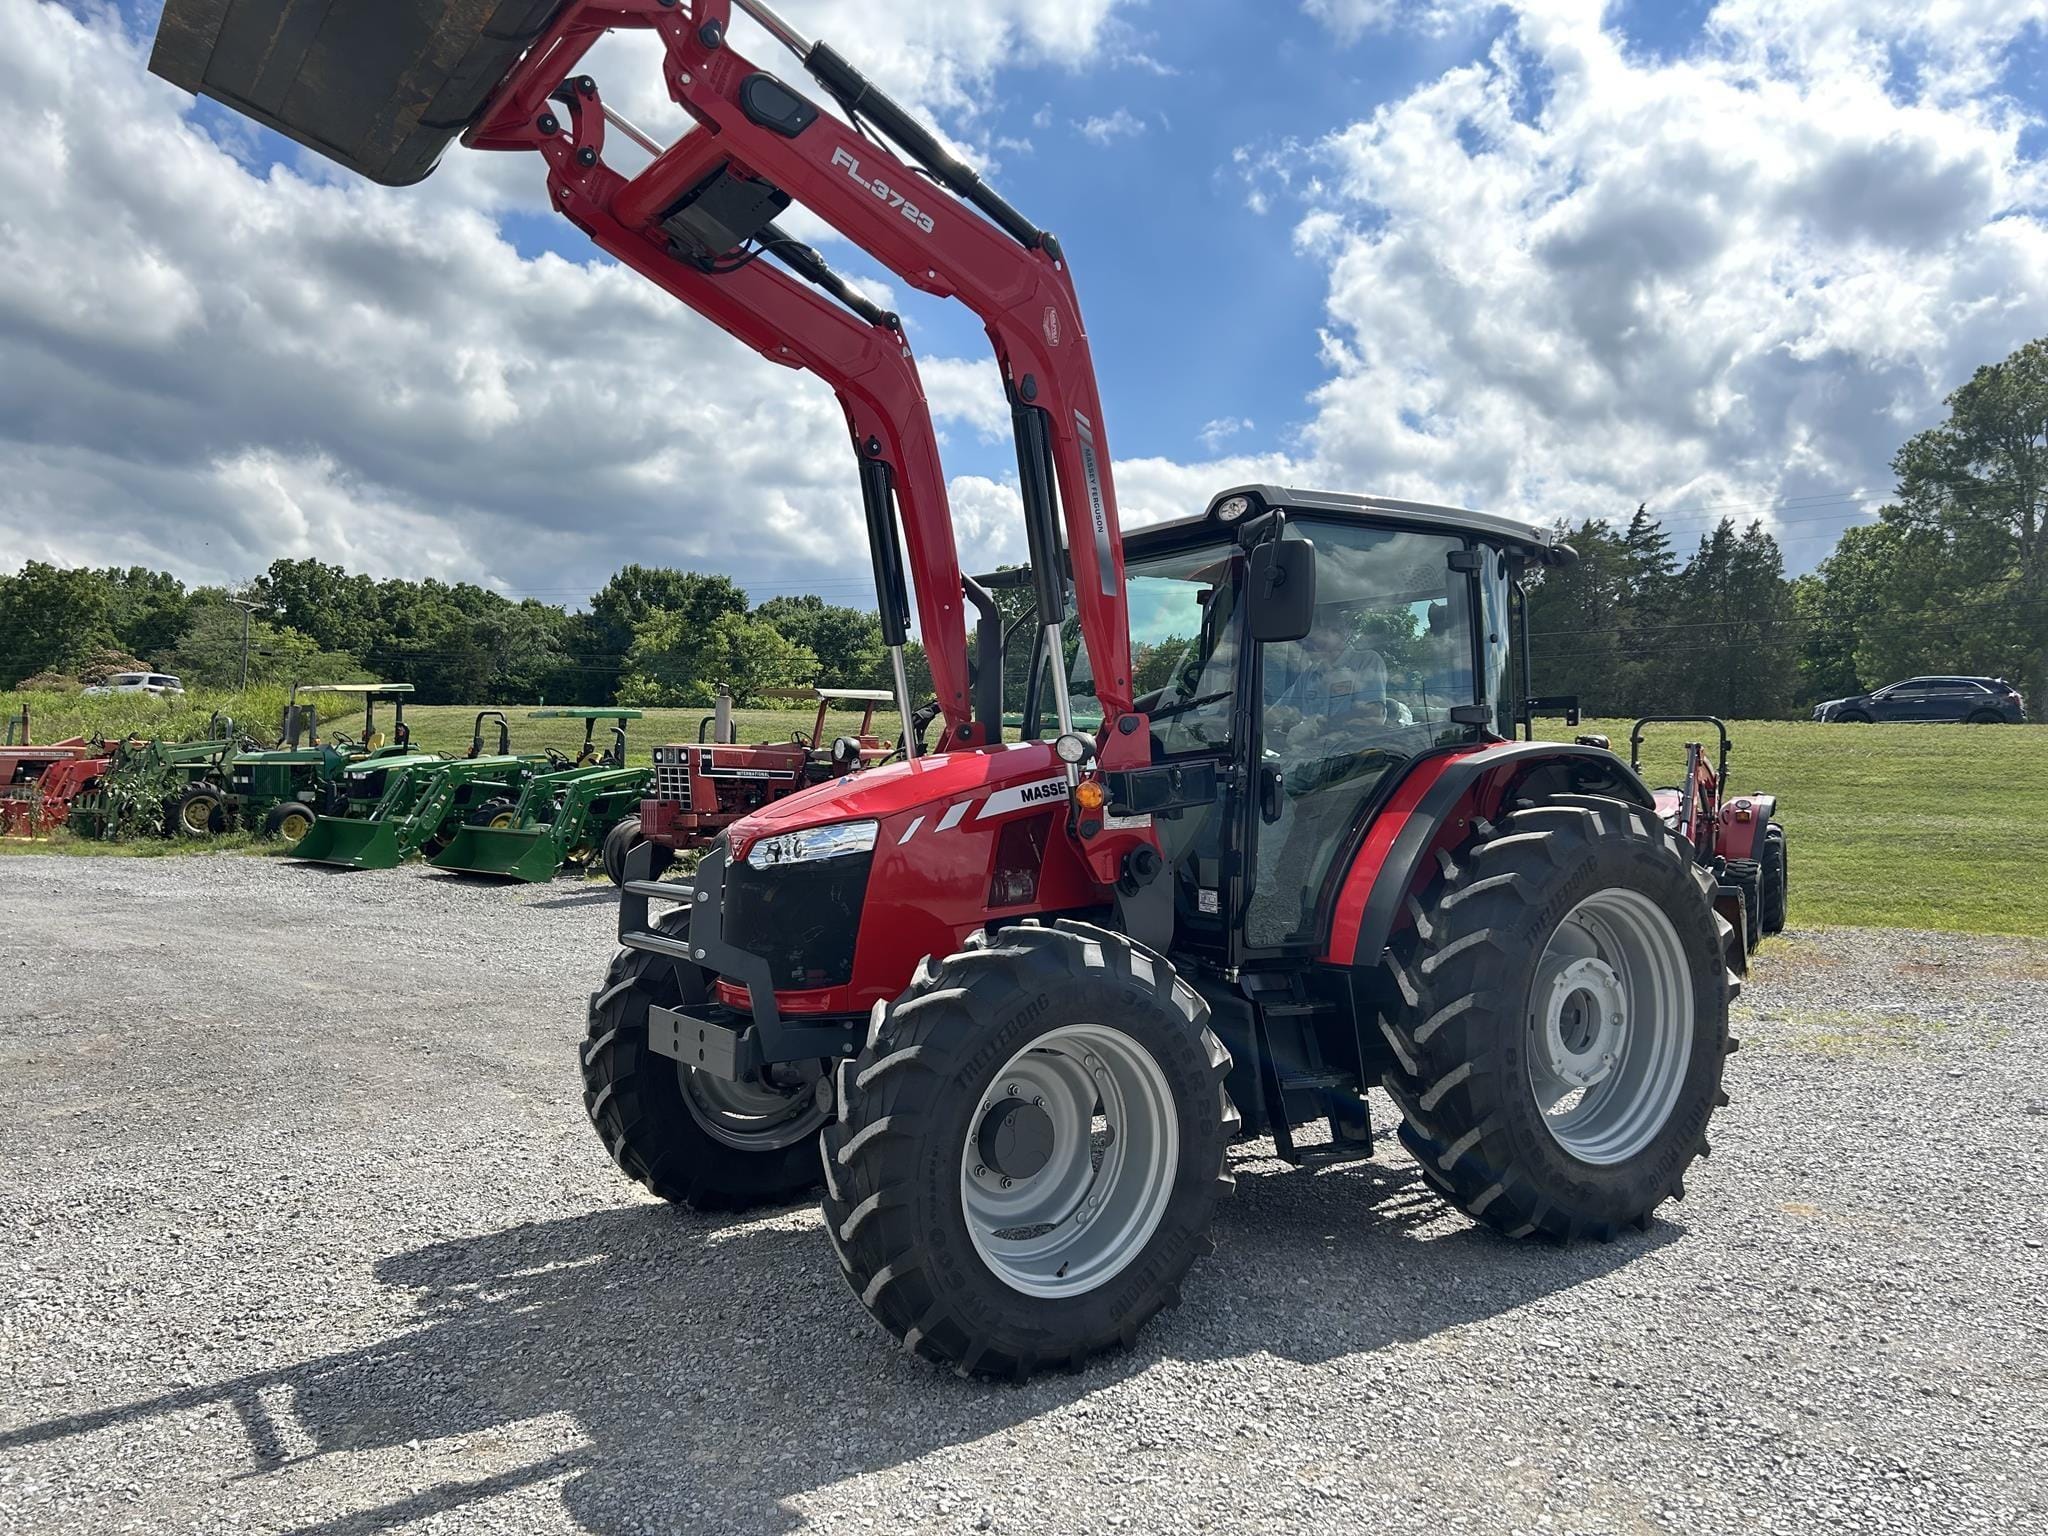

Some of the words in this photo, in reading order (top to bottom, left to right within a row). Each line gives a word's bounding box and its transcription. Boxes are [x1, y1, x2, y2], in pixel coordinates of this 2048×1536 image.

[831, 146, 935, 233] FL.3723
[1085, 448, 1097, 484] MASSEY
[1091, 486, 1104, 533] FERGUSON
[953, 993, 1050, 1090] TRELLEBORG
